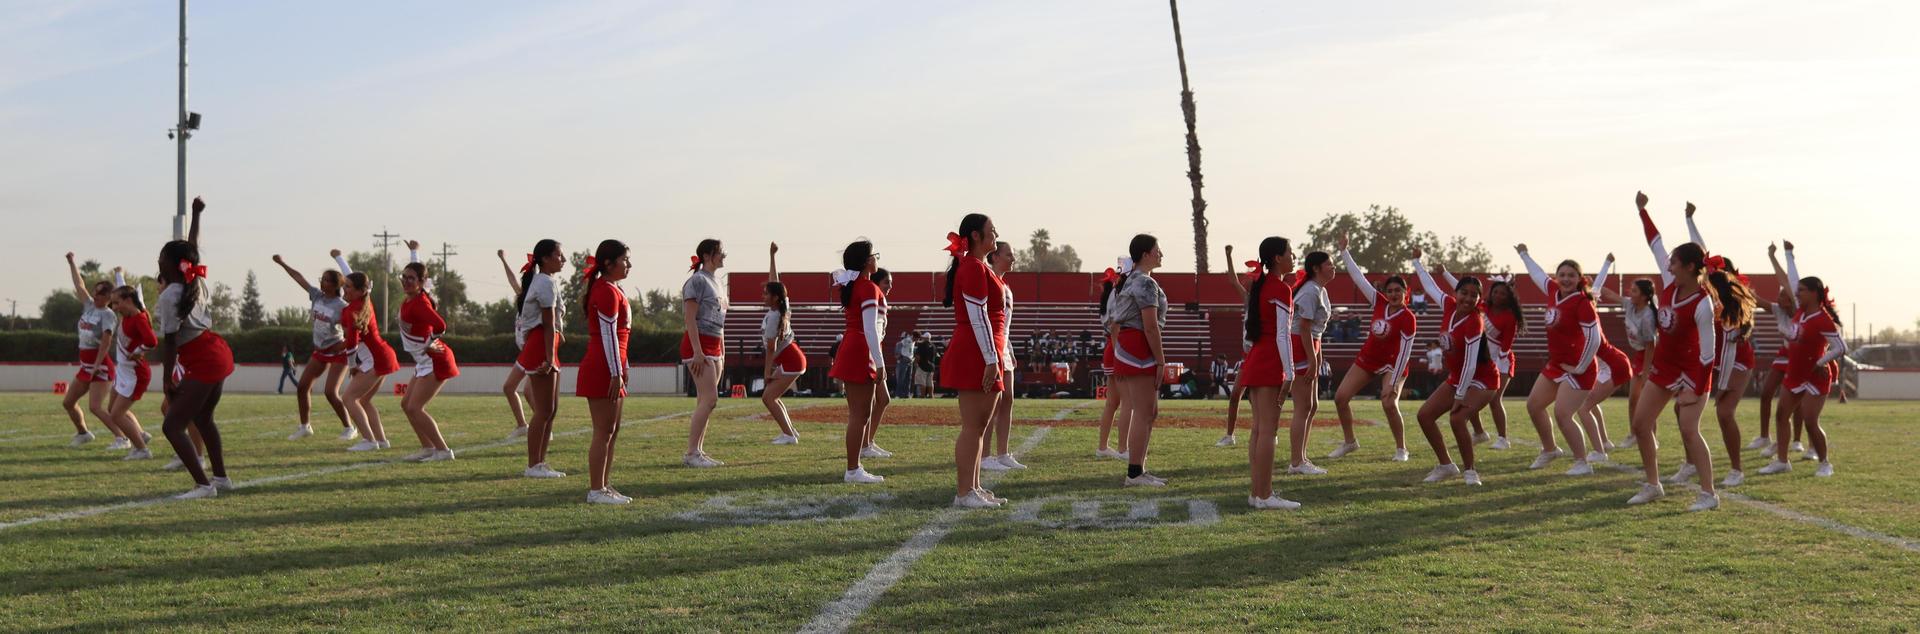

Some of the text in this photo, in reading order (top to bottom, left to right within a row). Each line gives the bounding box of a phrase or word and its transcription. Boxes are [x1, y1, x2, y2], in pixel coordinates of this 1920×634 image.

[54, 382, 66, 393] 20
[395, 383, 407, 394] 30
[732, 385, 744, 396] 40
